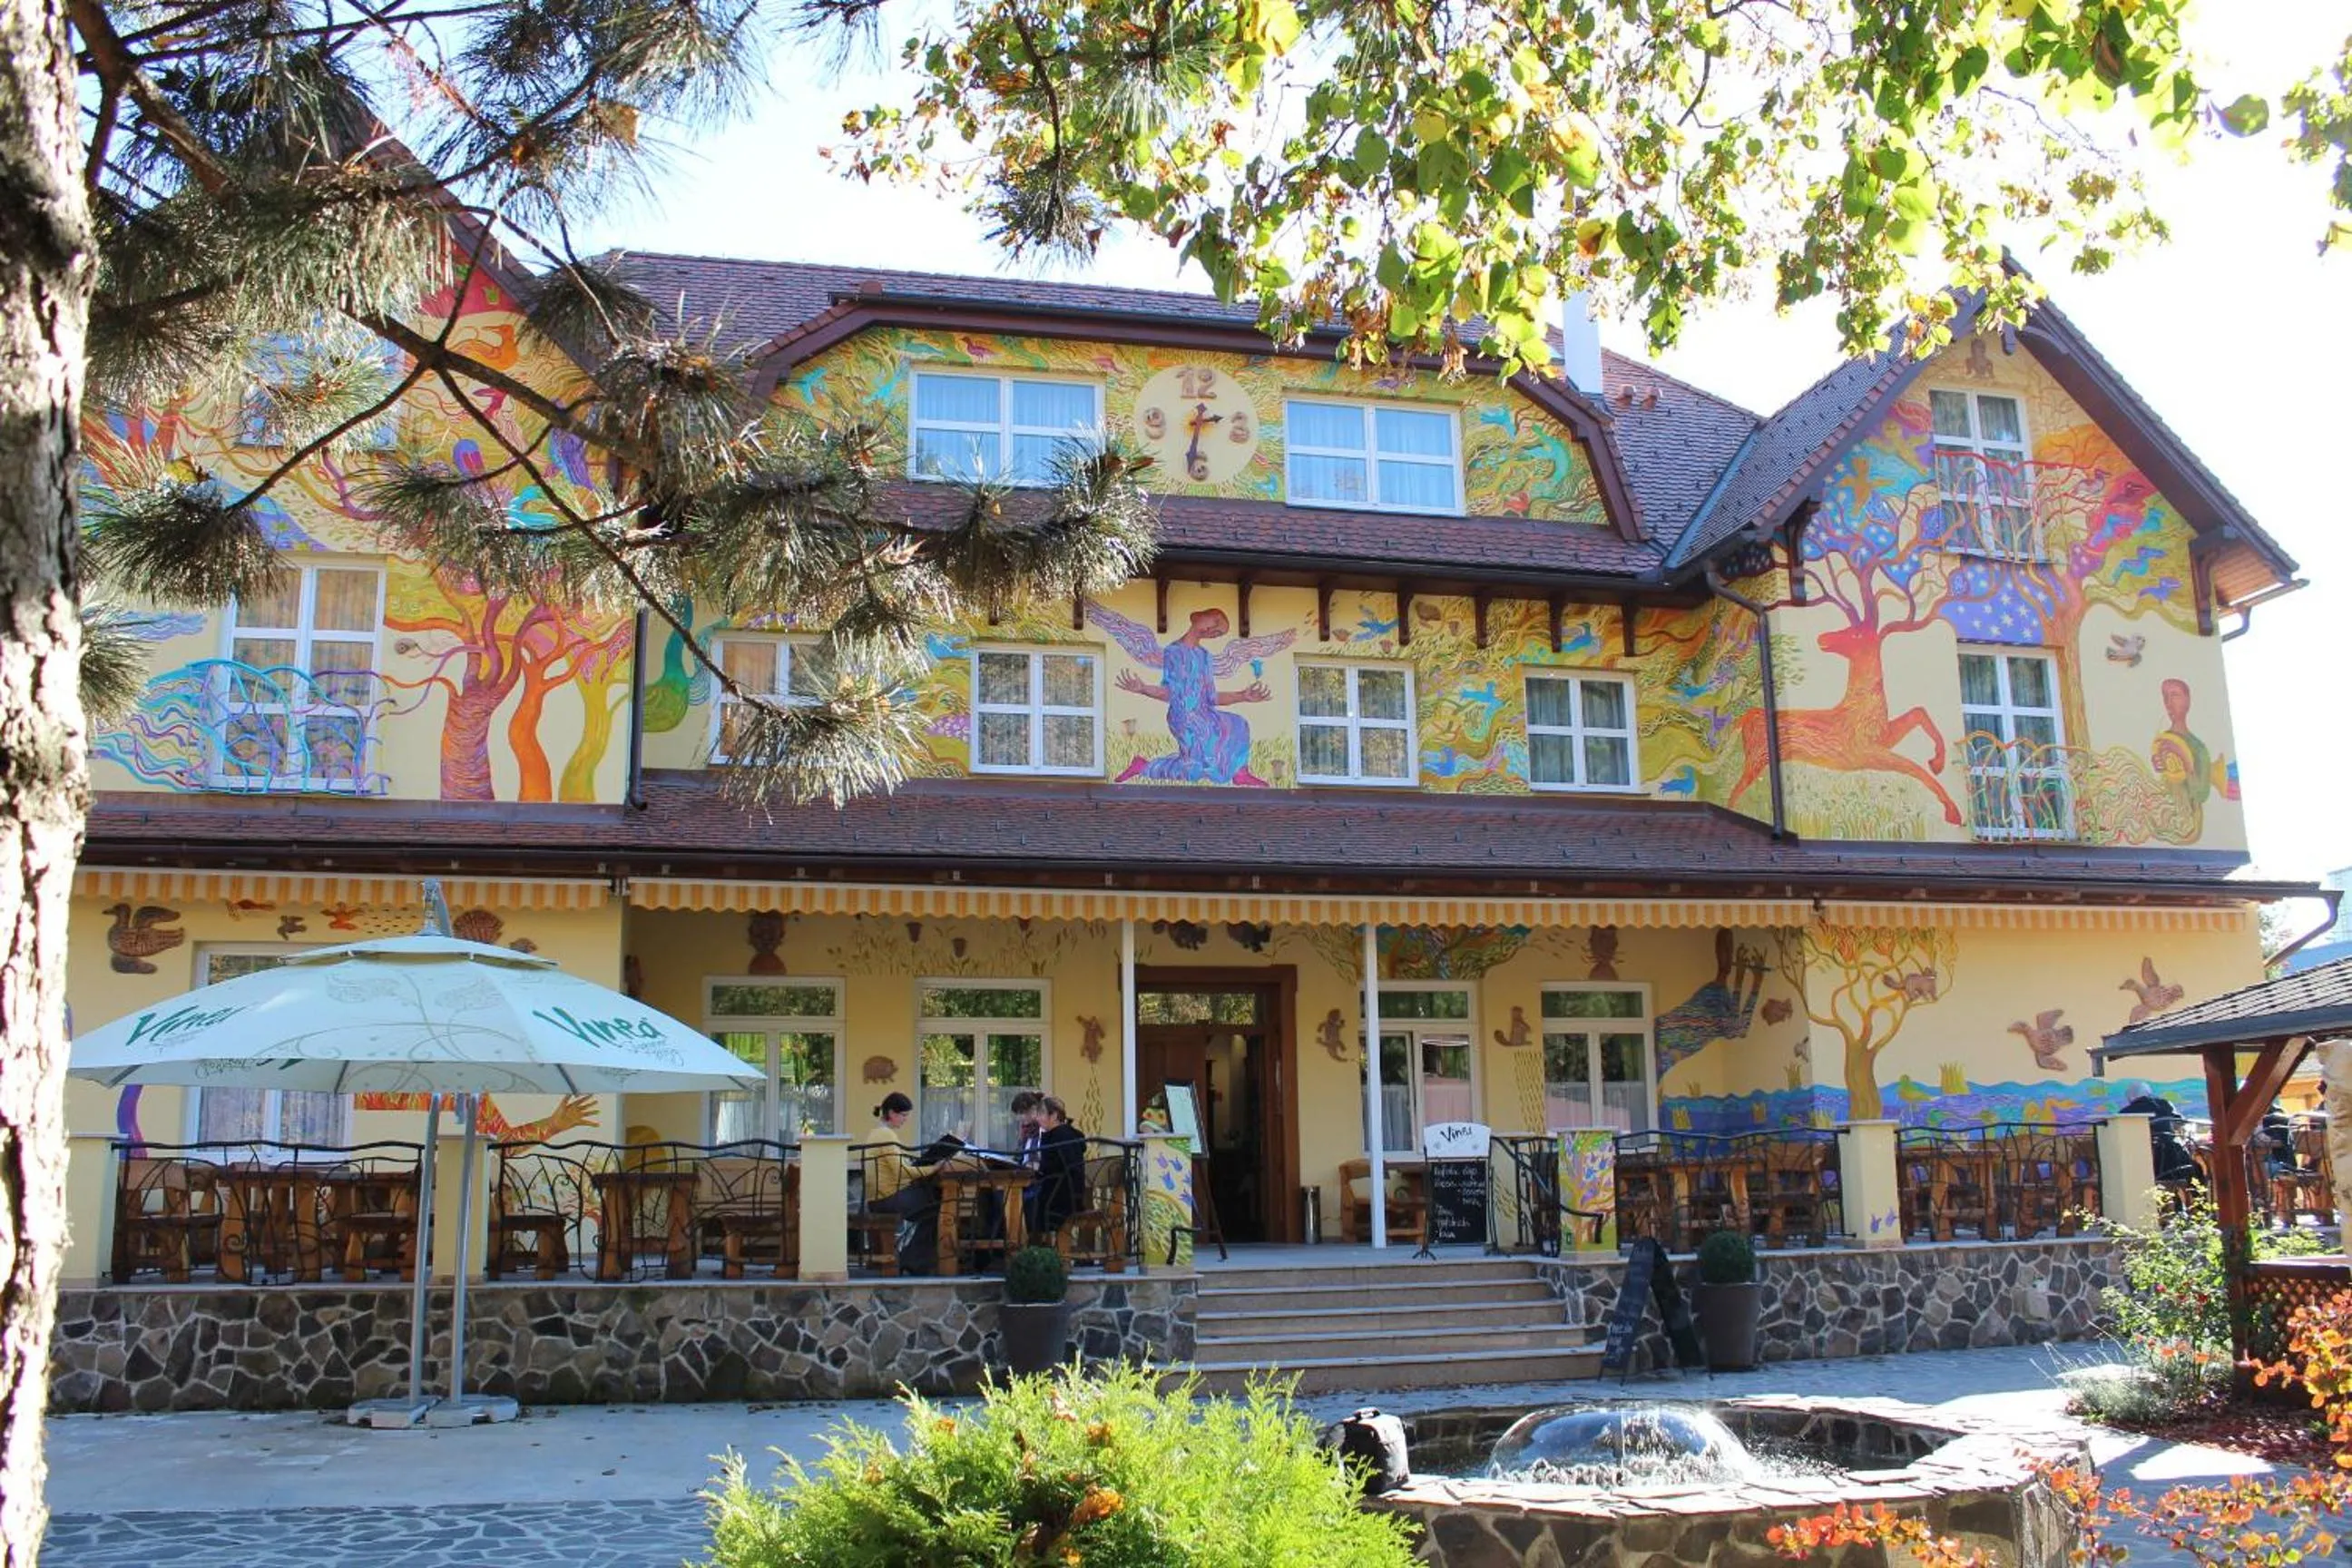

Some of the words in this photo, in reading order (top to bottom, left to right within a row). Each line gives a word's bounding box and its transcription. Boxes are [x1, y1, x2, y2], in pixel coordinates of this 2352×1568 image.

[1175, 368, 1217, 399] 12
[1144, 407, 1167, 440] 9
[1229, 411, 1250, 443] 3
[1190, 451, 1210, 482] 6
